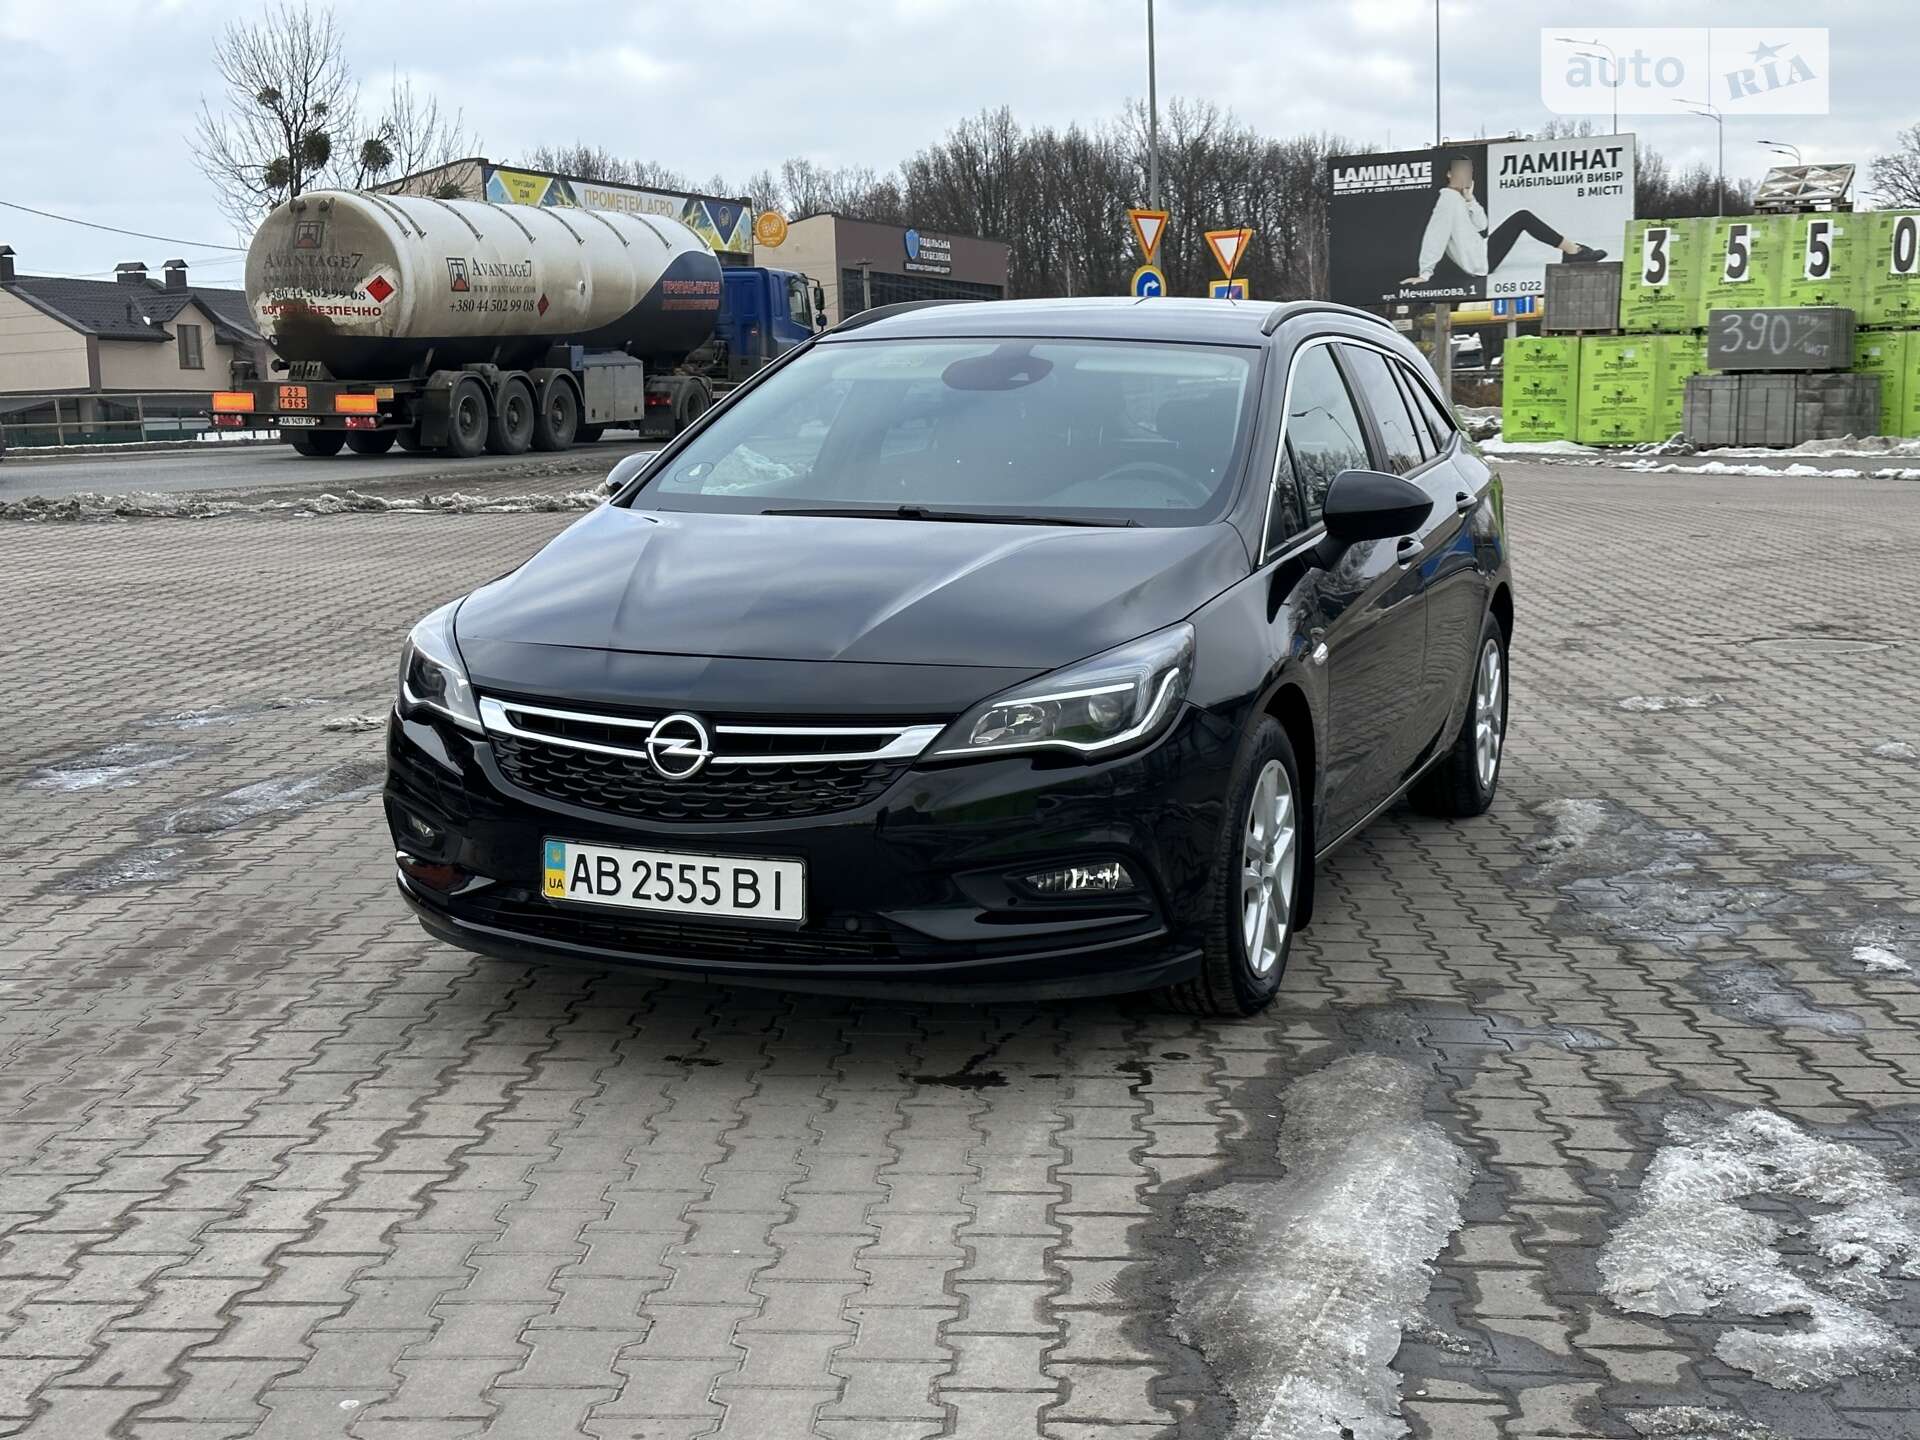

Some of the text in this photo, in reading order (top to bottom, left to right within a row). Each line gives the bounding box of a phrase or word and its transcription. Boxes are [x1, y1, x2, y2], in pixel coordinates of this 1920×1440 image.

[1500, 147, 1623, 175] ЛАМІНАТ
[1333, 161, 1432, 183] LAMINATE
[1499, 171, 1623, 189] НАЙБІЛЬШИЙ ВИБІР
[1577, 185, 1623, 197] В МІСТІ
[584, 188, 674, 215] ПРОМЕТЕЙ АГРО
[1645, 217, 1917, 284] 3 5 5 0
[350, 290, 366, 300] 08
[1400, 286, 1467, 299] Мечникова,
[1469, 285, 1477, 295] 1
[1494, 281, 1542, 293] 068 022
[449, 299, 535, 313] +380 44 502 99 08
[1719, 313, 1790, 355] 390
[287, 388, 299, 397] 23
[549, 877, 564, 889] UA
[570, 854, 781, 910] AB 2555 BI
